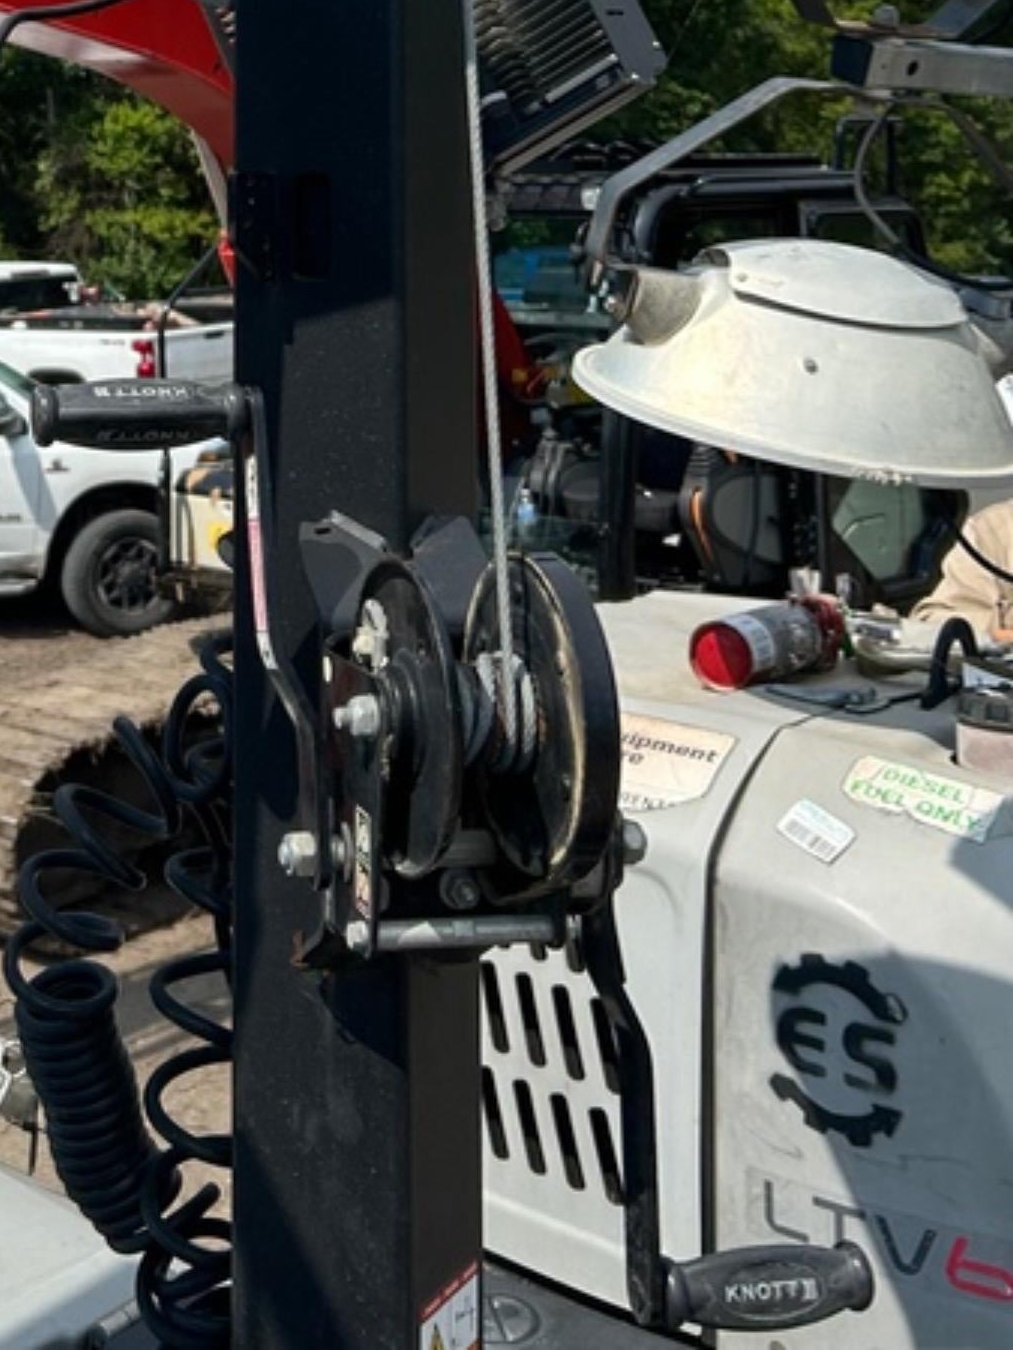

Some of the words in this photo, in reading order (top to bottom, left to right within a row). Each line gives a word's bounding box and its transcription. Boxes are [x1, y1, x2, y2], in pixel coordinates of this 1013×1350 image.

[881, 766, 965, 804] DIESEL
[851, 779, 905, 807] FUEL
[915, 800, 981, 831] ONLY
[725, 1280, 797, 1302] KNOTT
